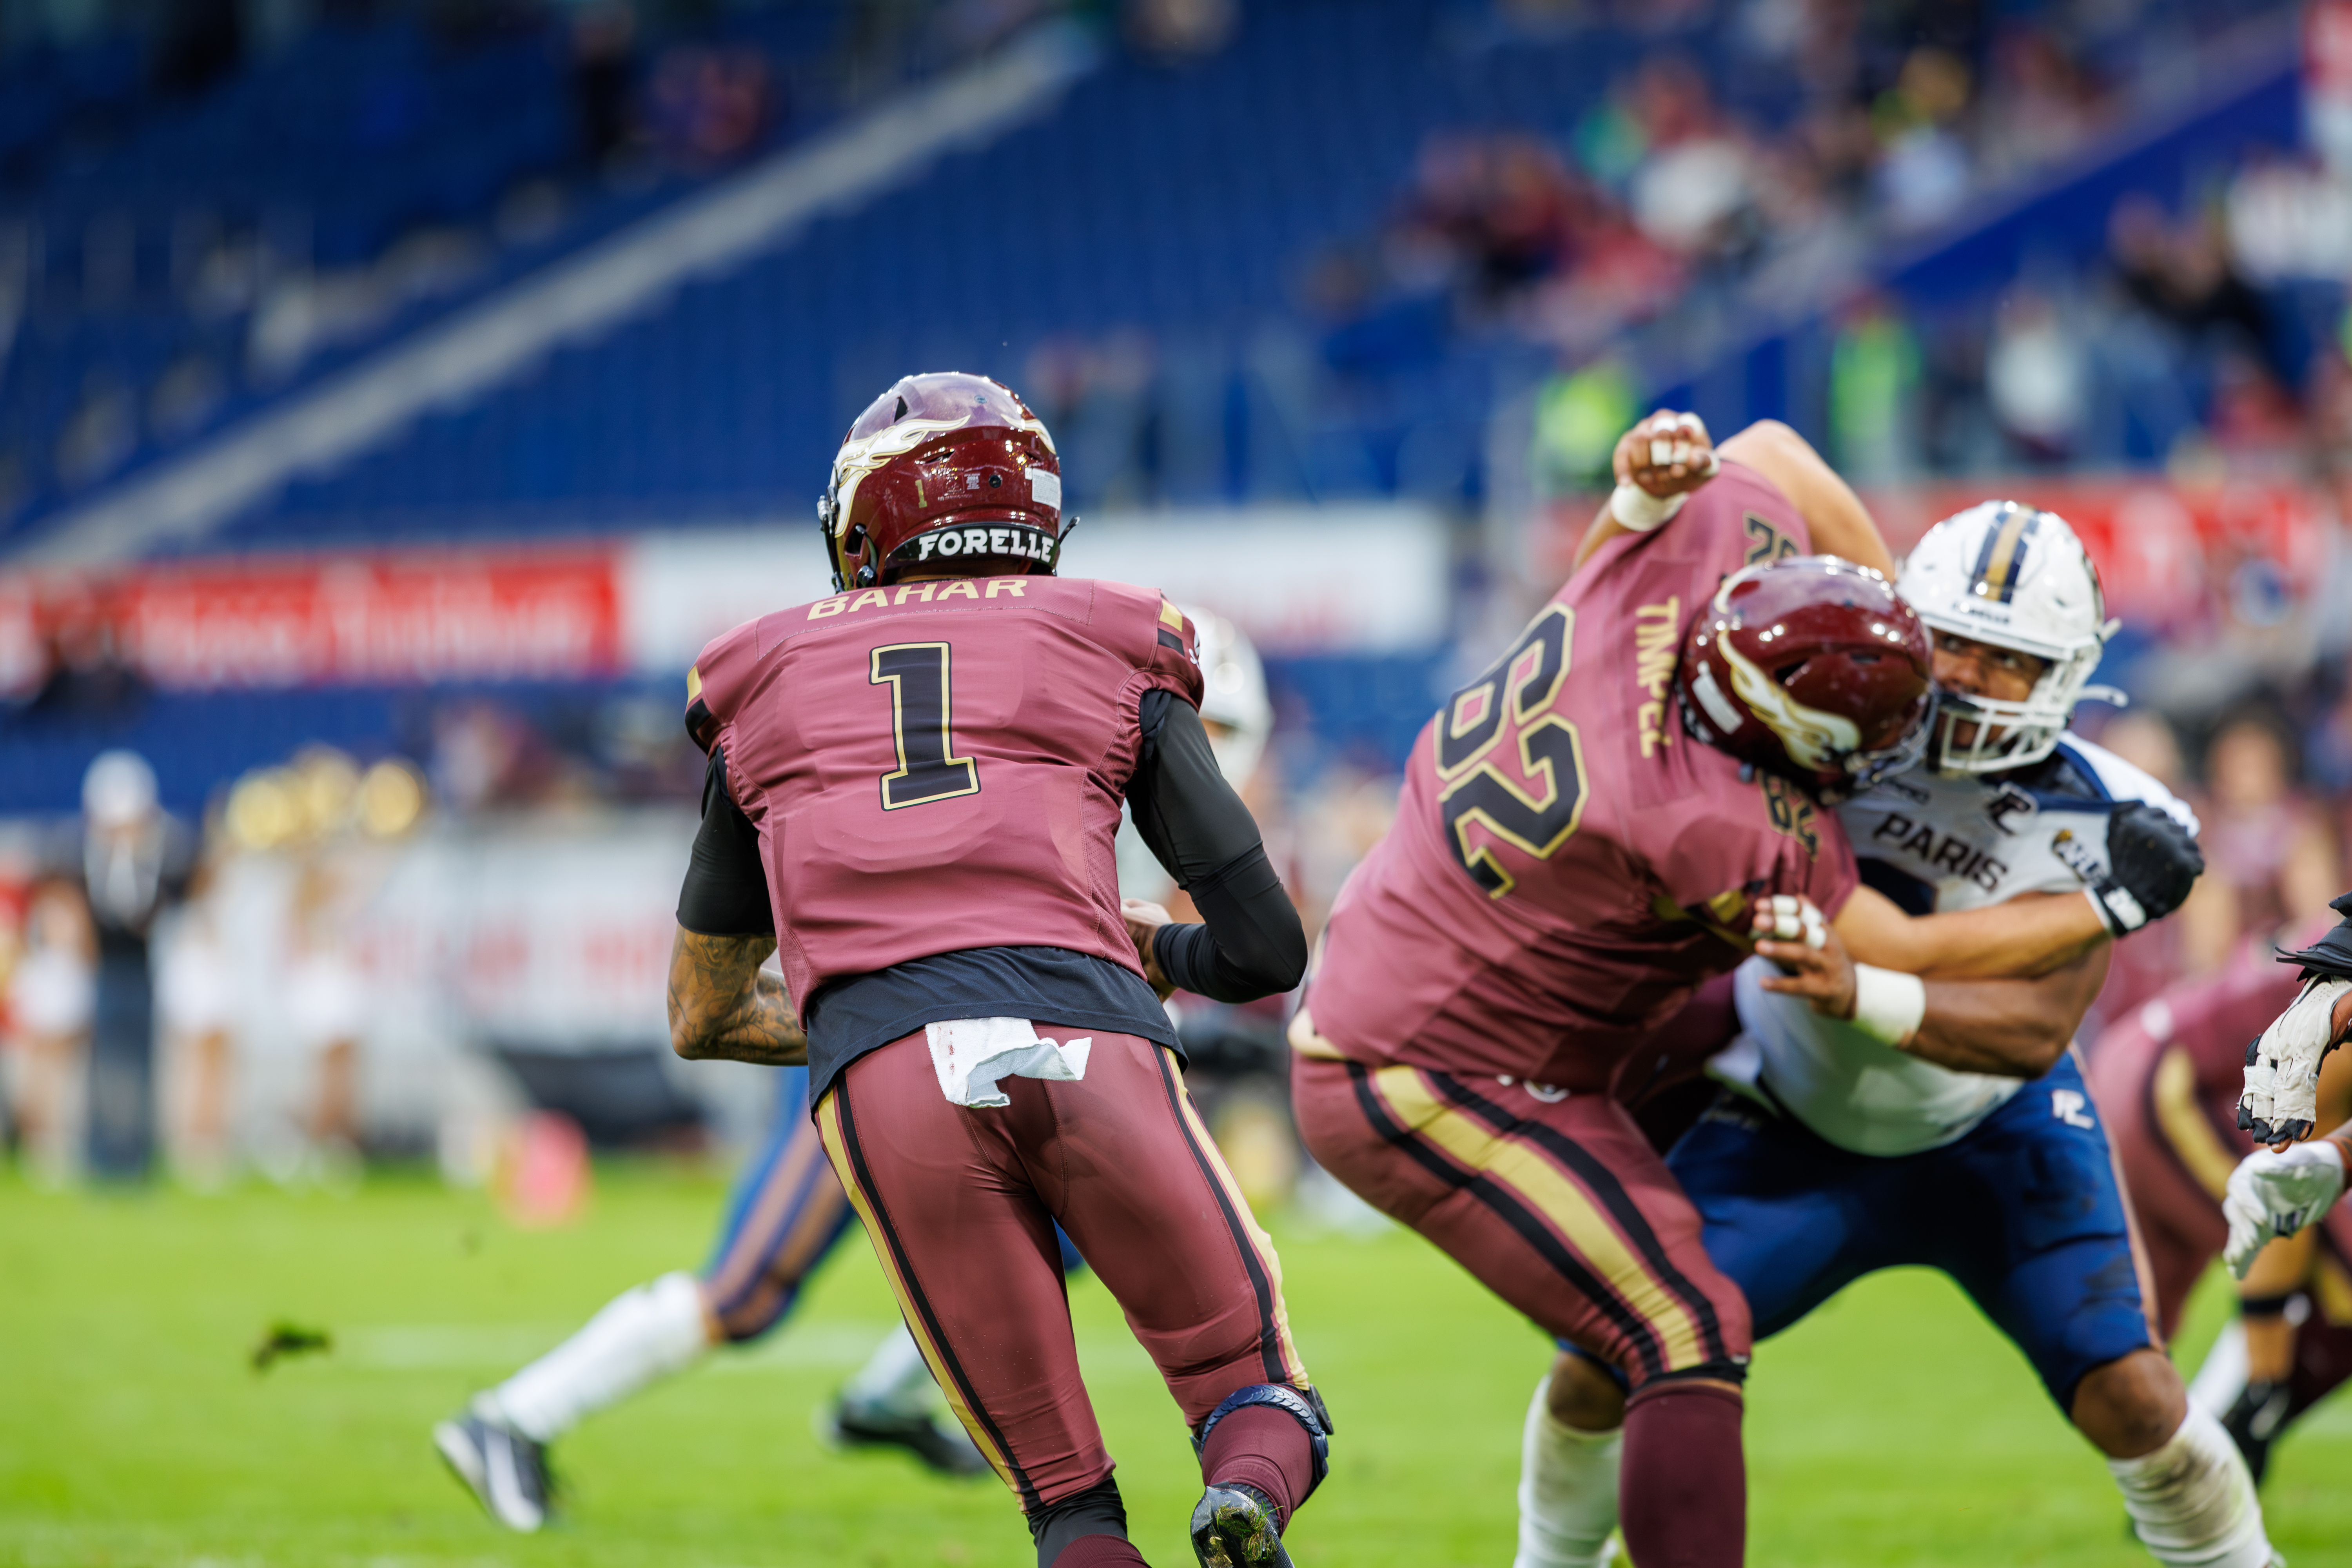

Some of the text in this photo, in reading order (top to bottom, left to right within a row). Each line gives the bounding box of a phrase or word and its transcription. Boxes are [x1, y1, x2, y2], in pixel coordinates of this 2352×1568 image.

[915, 479, 927, 508] 1
[919, 528, 1054, 563] FORELLE
[807, 579, 1027, 620] BAHAR
[869, 641, 982, 811] 1
[1433, 602, 1589, 900] 62
[1873, 811, 2009, 894] PARIS
